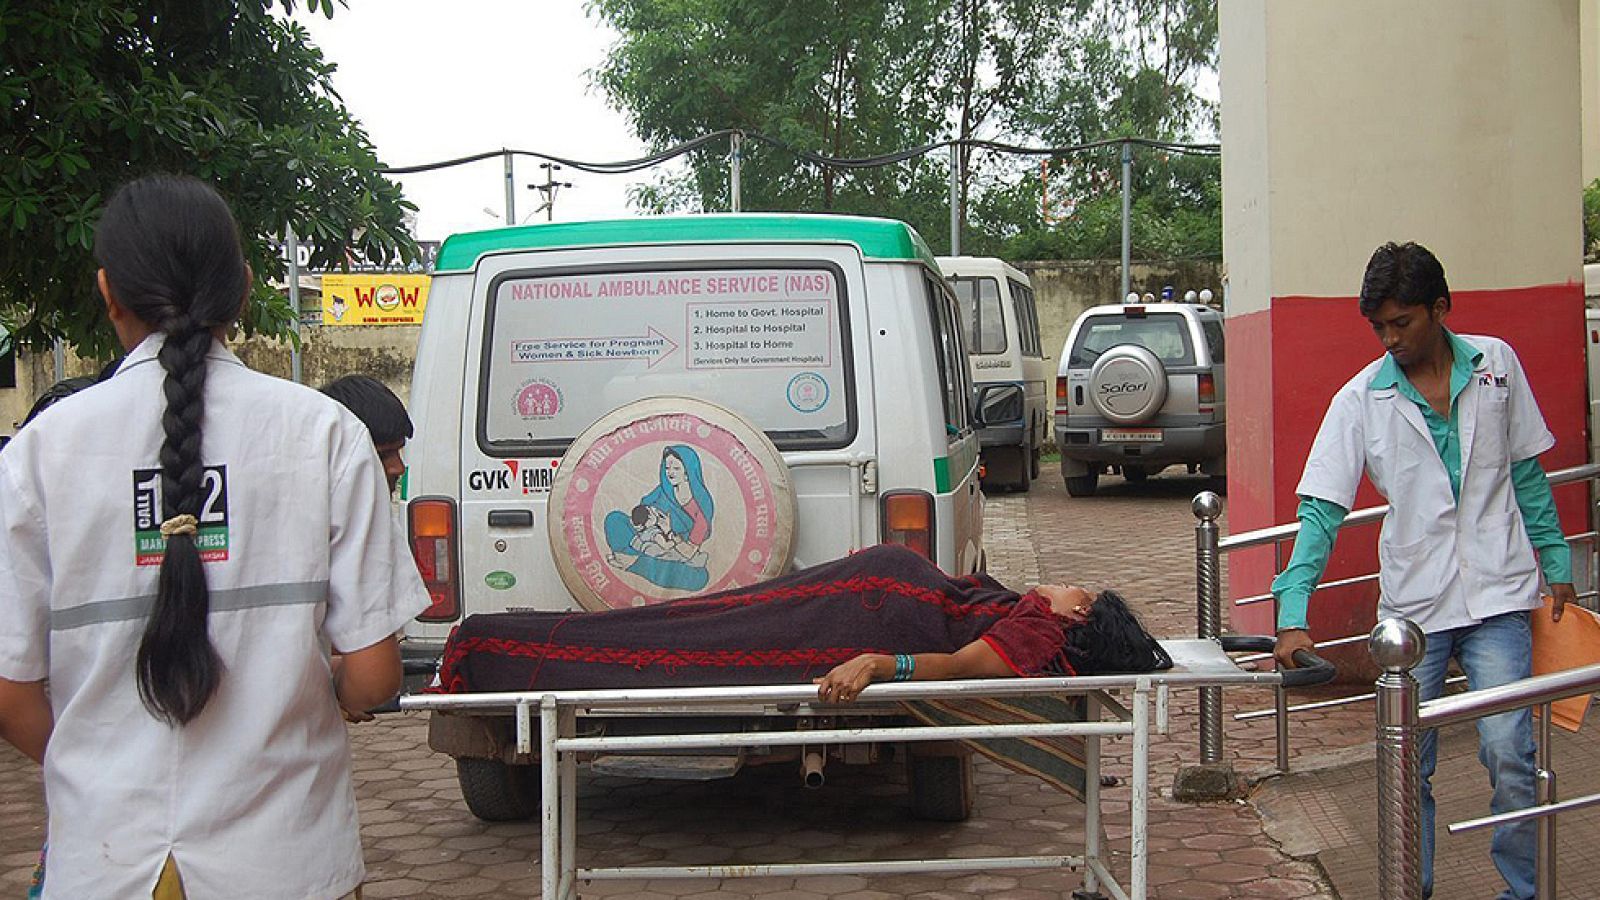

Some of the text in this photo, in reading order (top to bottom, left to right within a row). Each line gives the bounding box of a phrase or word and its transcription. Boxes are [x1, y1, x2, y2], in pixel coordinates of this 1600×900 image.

[512, 274, 830, 300] NATIONAL AMBULANCE SERVICE (NAS)
[706, 309, 735, 318] Home
[738, 309, 749, 317] to
[750, 308, 777, 317] Govt.
[781, 307, 824, 317] Hospital
[693, 323, 806, 335] 2. Hospital to Hospital
[515, 338, 664, 351] Free Service for Pregnant
[693, 340, 794, 351] 3. Hospital to Home
[518, 348, 660, 360] Women & Sick Newborn
[1100, 381, 1149, 394] Safari
[469, 468, 553, 491] GVK EMRI
[136, 492, 151, 529] CALL
